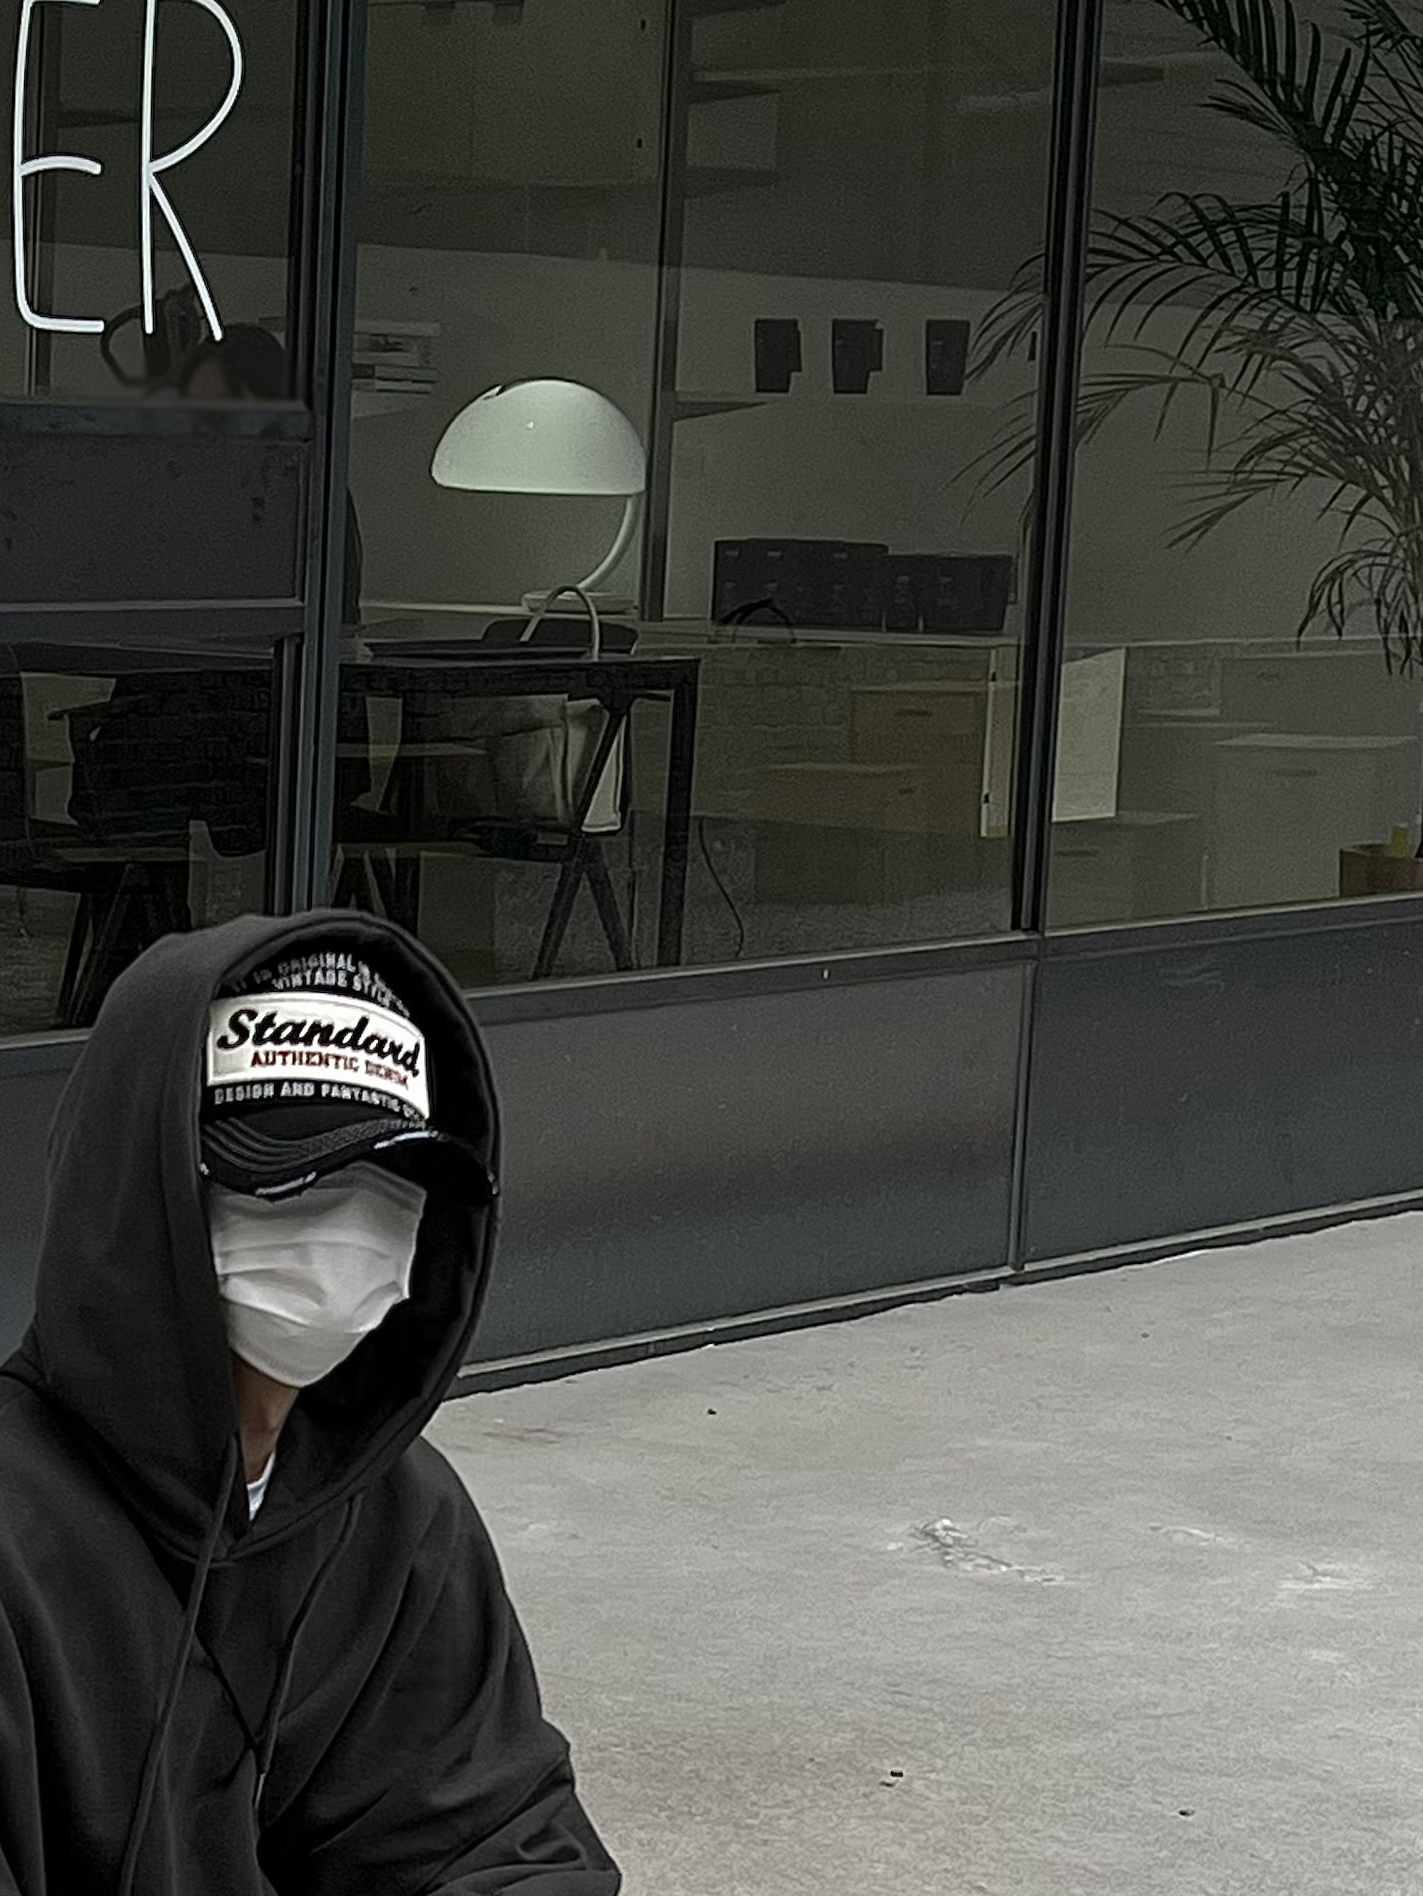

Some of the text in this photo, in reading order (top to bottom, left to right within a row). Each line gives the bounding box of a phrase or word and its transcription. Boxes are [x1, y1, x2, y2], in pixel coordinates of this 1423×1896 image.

[216, 1008, 421, 1078] Standard
[250, 1050, 360, 1073] AUTHENTIC
[280, 1080, 315, 1097] AND
